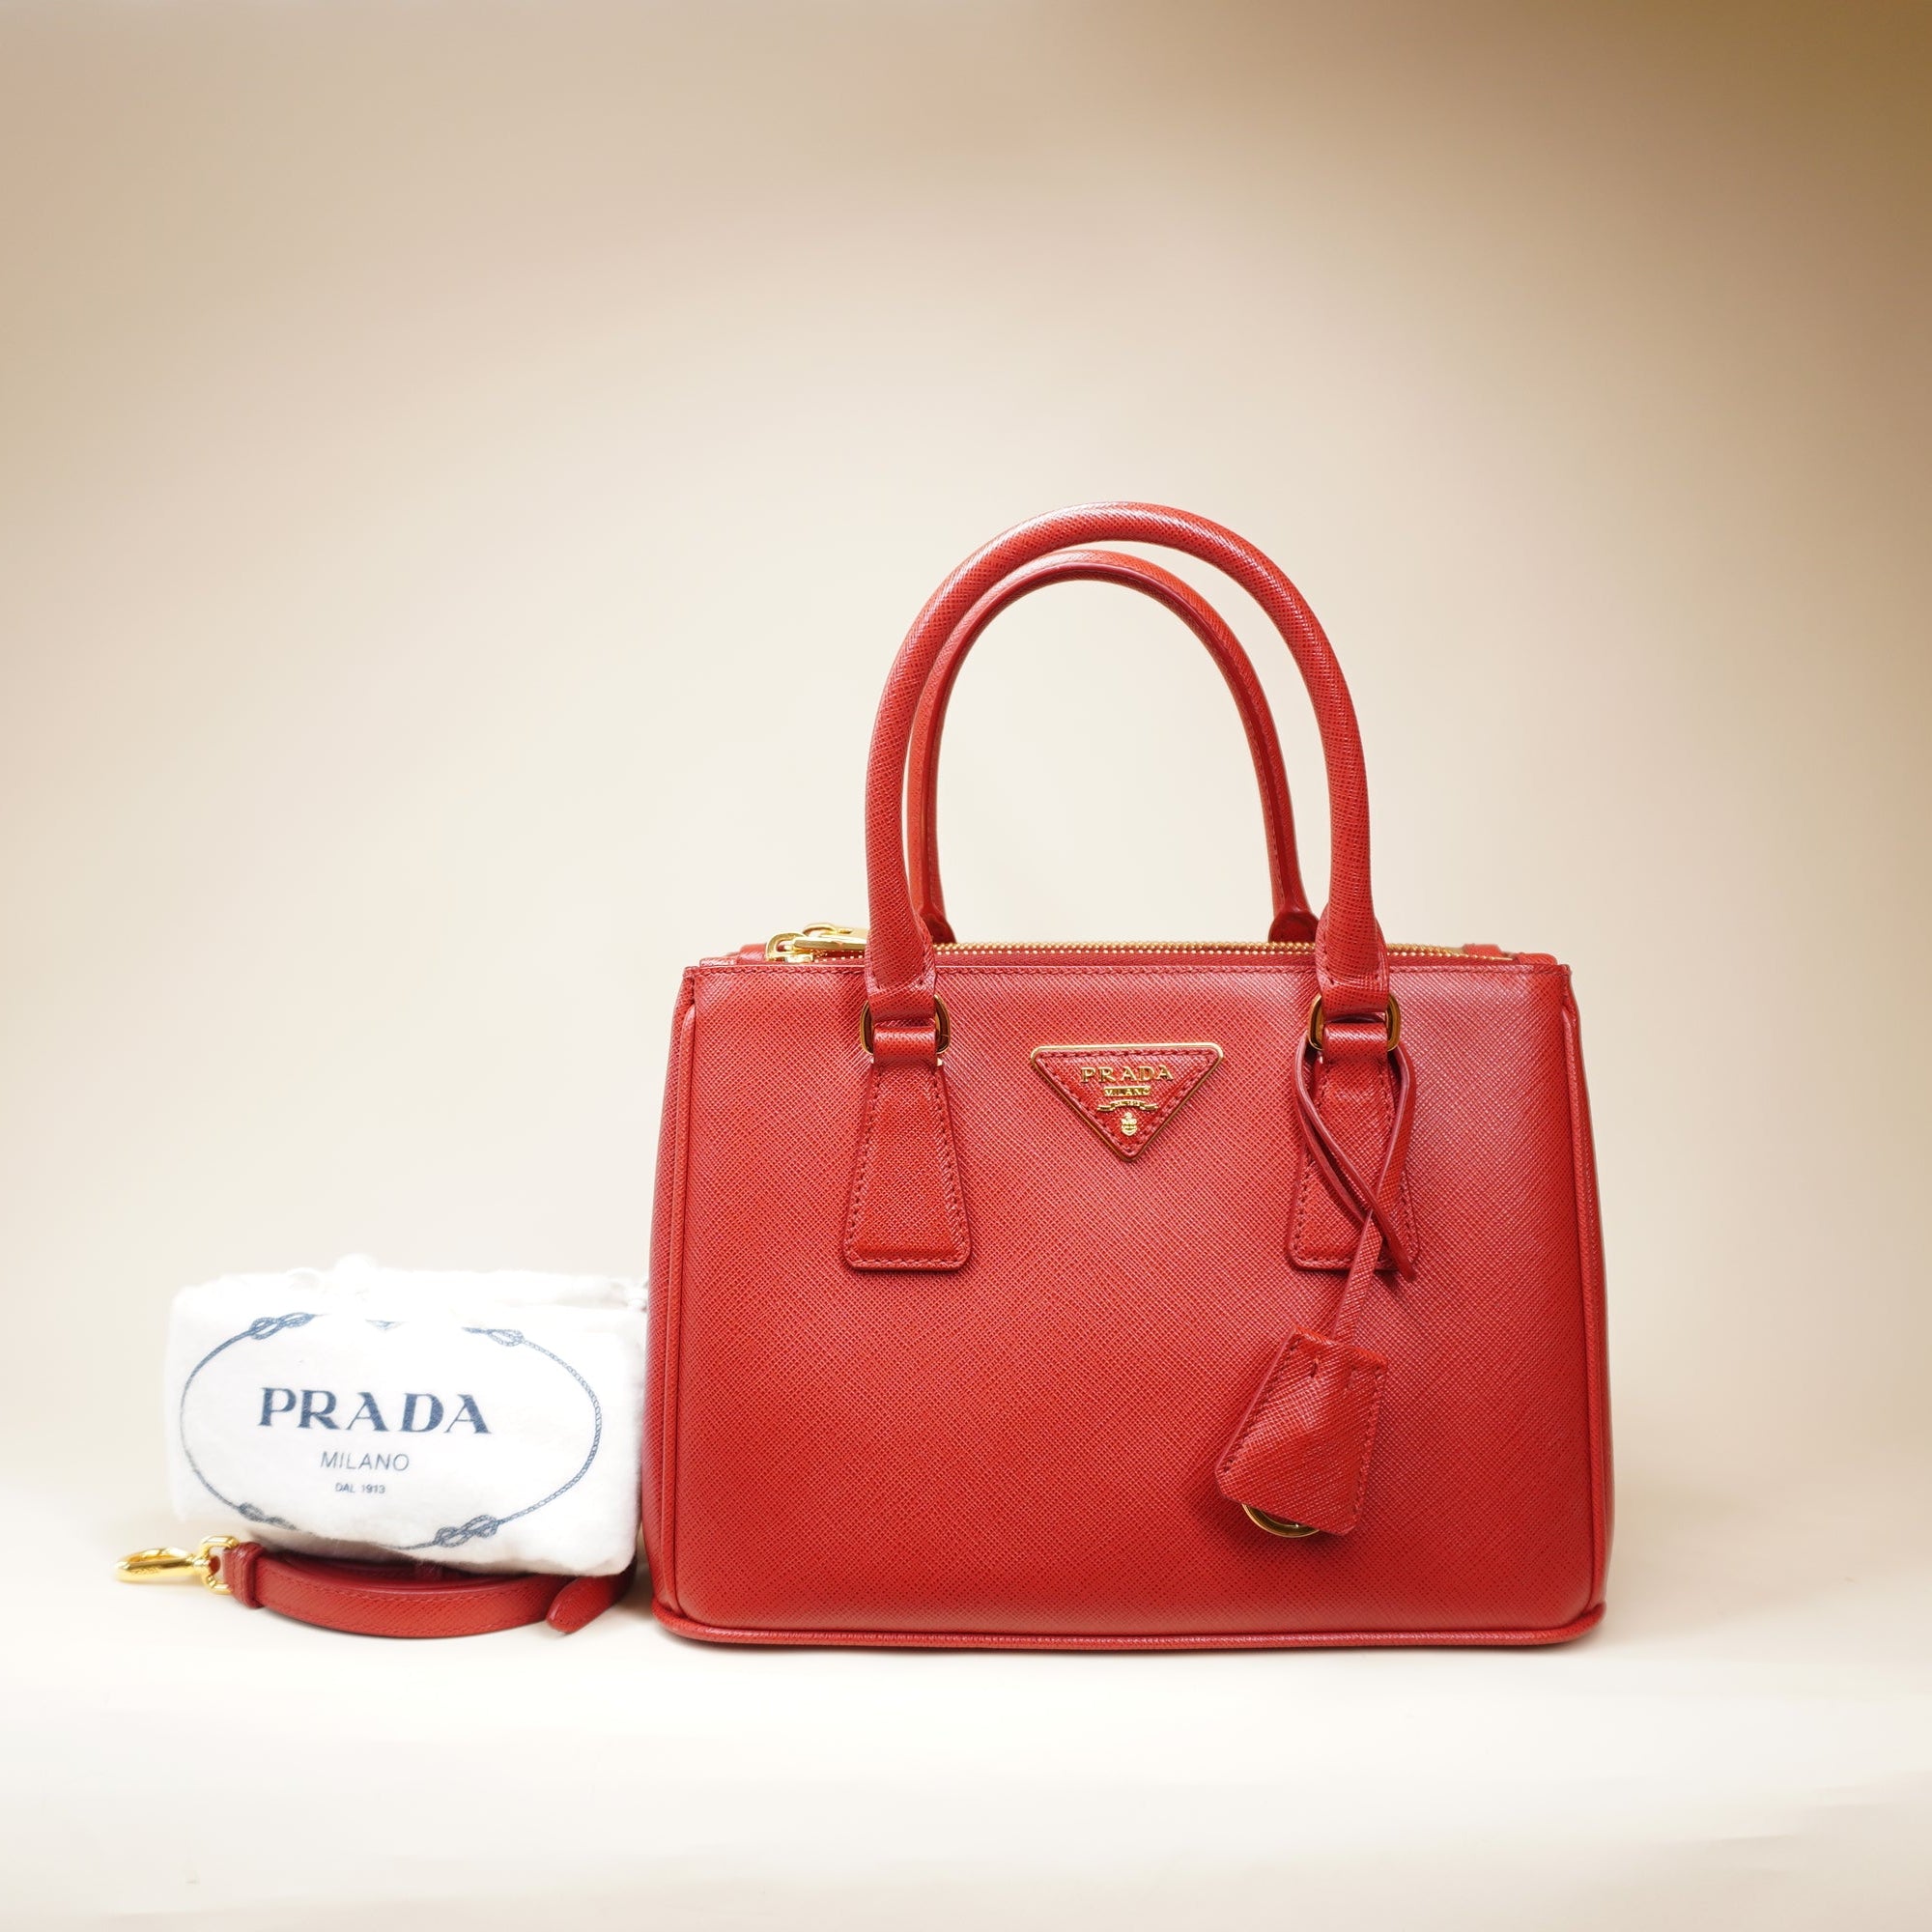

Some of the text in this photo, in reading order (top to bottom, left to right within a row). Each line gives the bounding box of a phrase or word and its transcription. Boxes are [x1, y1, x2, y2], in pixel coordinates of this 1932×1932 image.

[1081, 1065, 1174, 1082] PRADA
[258, 1387, 492, 1434] PRADA
[320, 1451, 410, 1471] MILANO
[334, 1483, 385, 1494] DAL 1913
